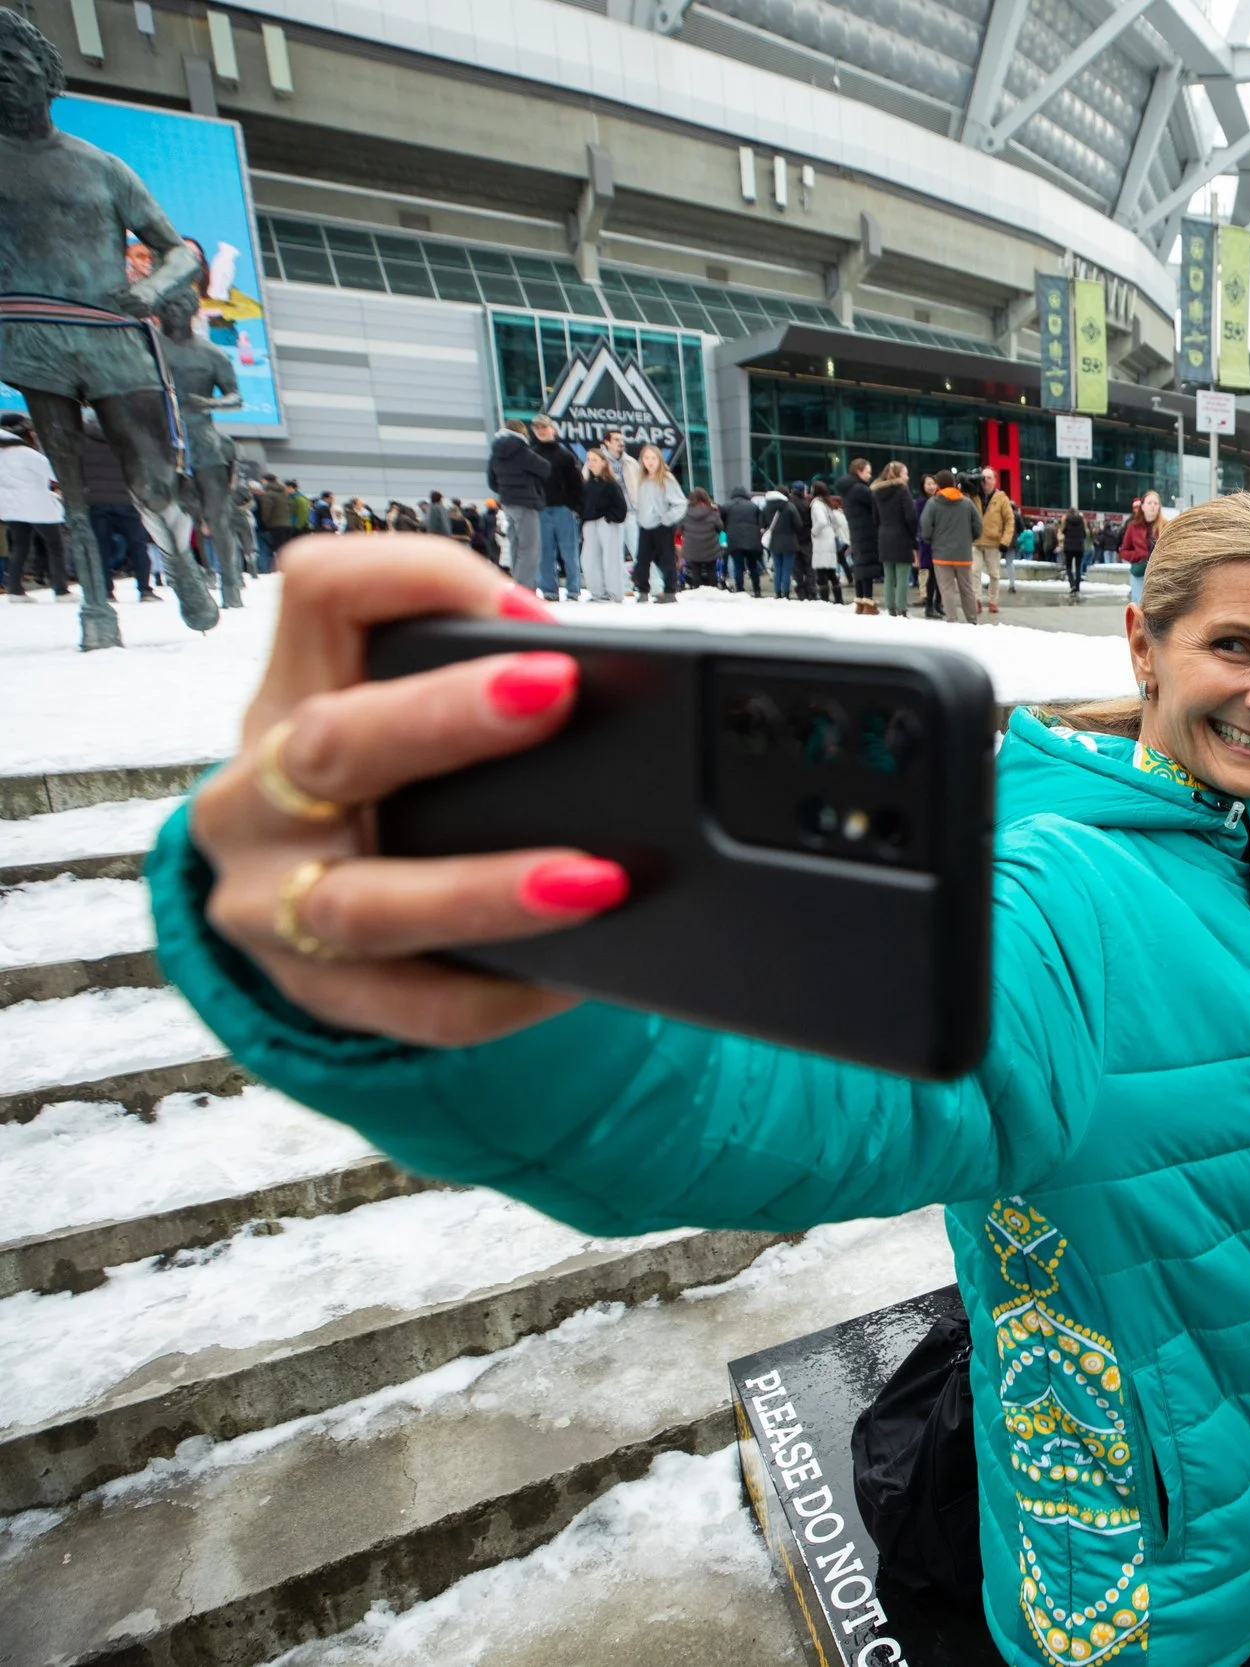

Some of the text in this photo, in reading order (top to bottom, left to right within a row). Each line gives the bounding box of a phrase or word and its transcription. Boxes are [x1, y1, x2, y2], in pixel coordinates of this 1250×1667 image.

[568, 406, 653, 424] VANCOUVER
[744, 1369, 823, 1491] PLEASE
[792, 1484, 845, 1544] DO
[816, 1541, 888, 1635] NOT
